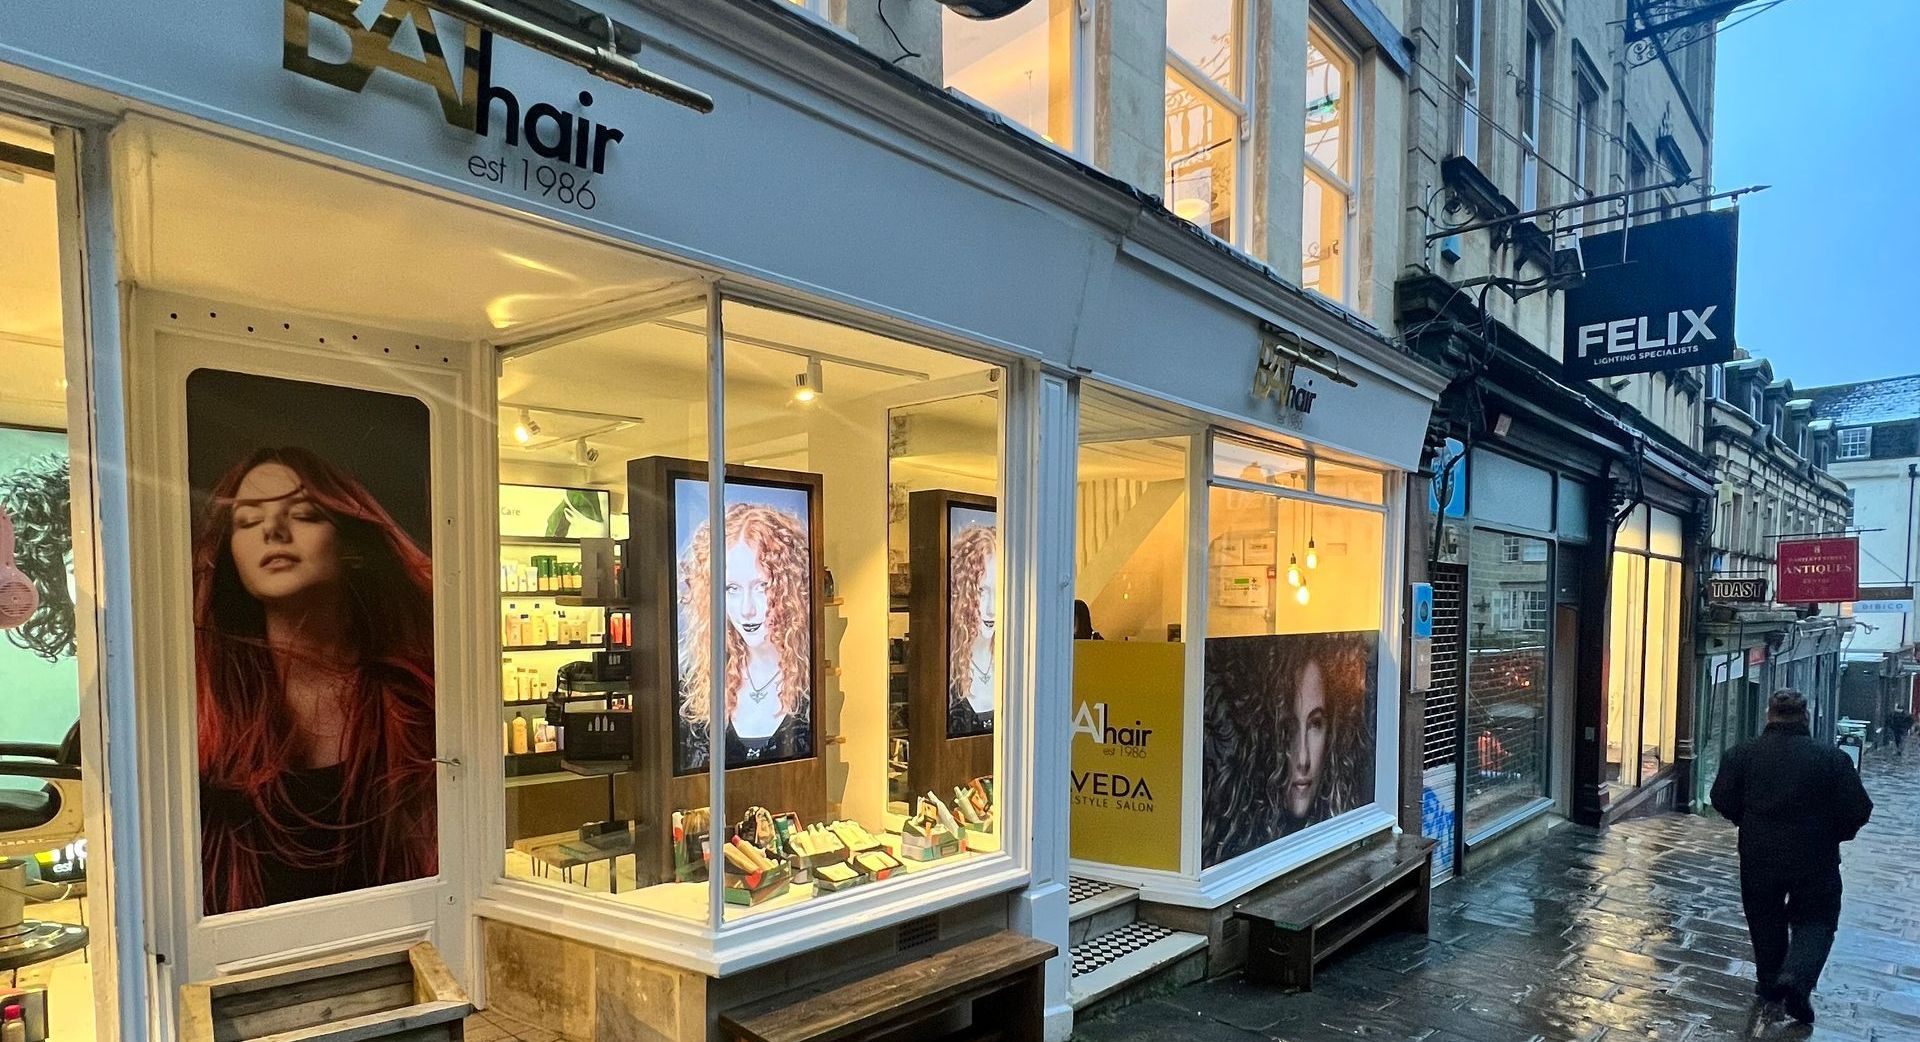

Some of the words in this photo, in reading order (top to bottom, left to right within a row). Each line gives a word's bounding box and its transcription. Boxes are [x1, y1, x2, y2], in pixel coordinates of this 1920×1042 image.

[467, 155, 506, 184] est
[520, 158, 597, 210] 1986
[1578, 305, 1718, 358] FELIX
[1593, 352, 1636, 365] LIGHTING
[1638, 345, 1699, 360] SPECIALISTS
[501, 506, 521, 516] Care
[1783, 563, 1852, 575] ANTIQUES
[1711, 581, 1764, 598] TOAST
[1102, 748, 1115, 757] est
[1119, 746, 1147, 759] 1986
[1070, 770, 1153, 801] VEDA
[1070, 795, 1108, 808] STYLE
[1116, 799, 1154, 813] SALON
